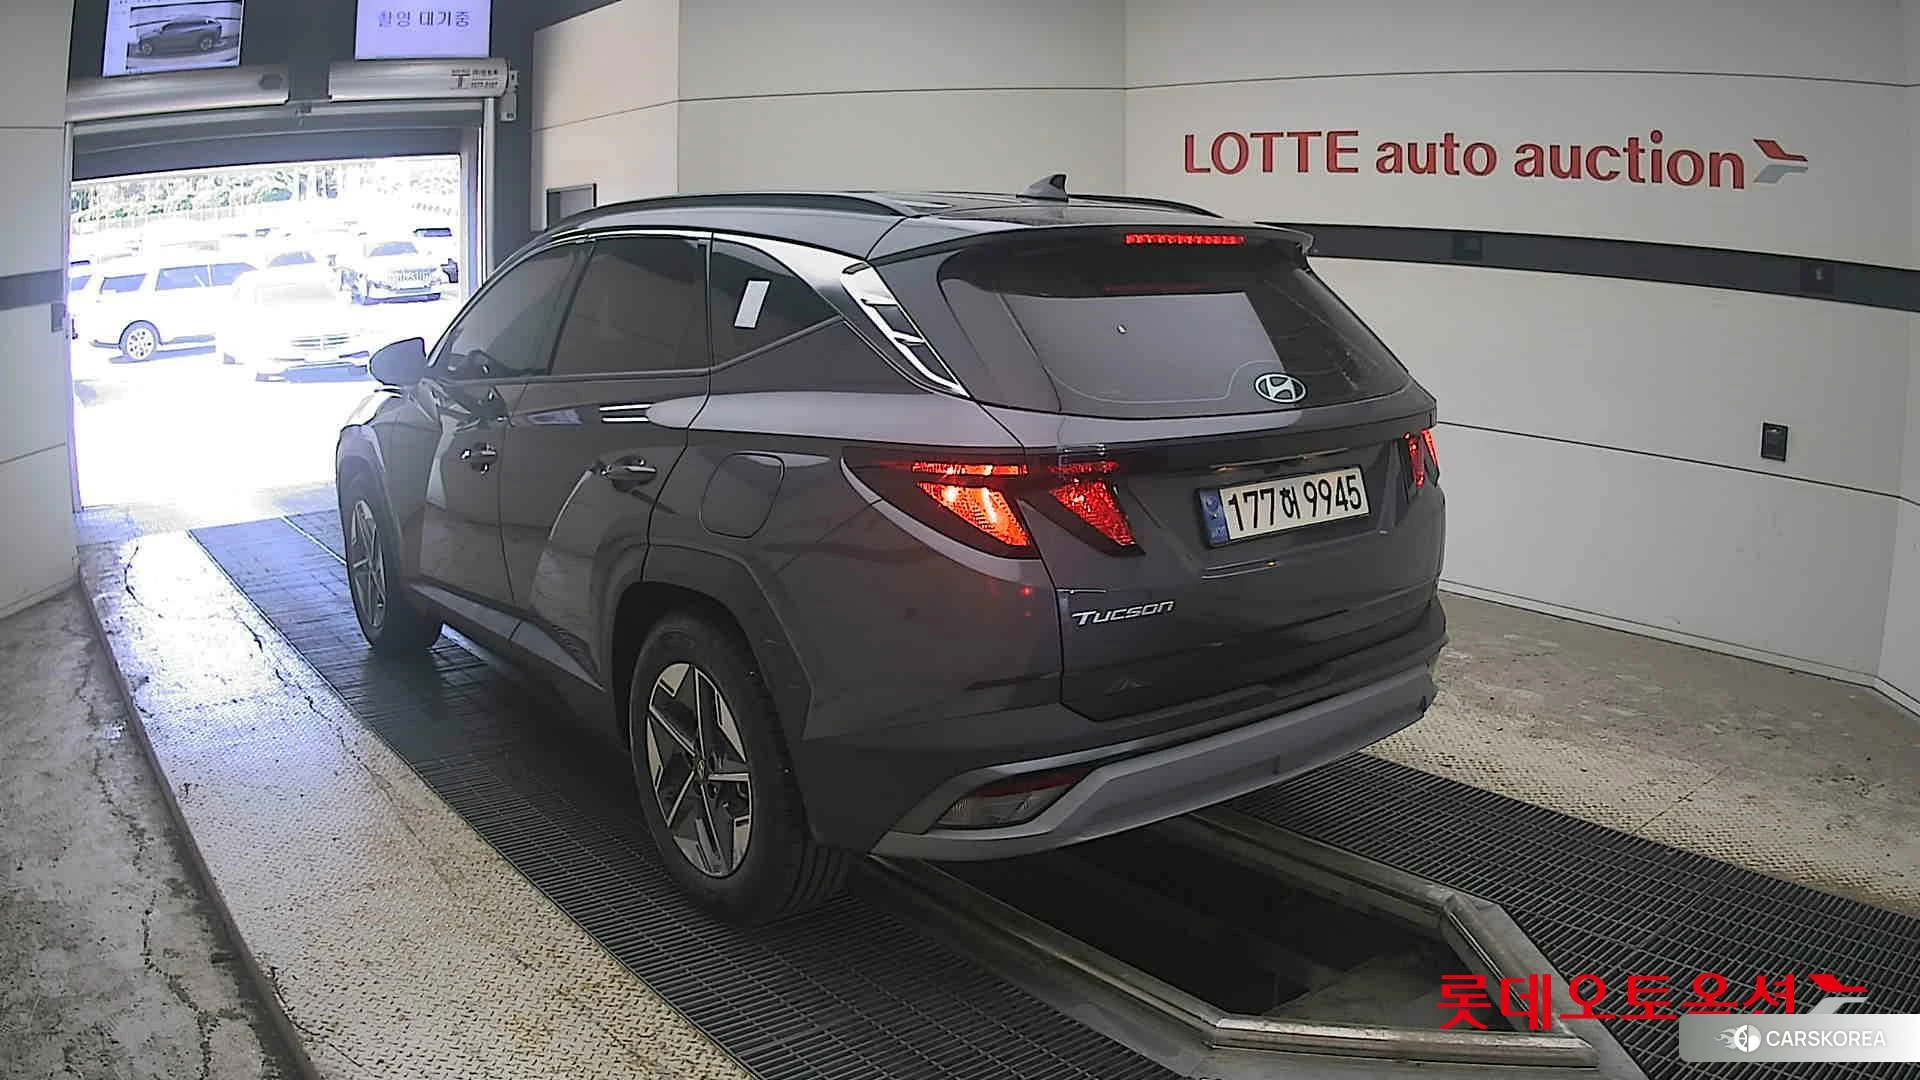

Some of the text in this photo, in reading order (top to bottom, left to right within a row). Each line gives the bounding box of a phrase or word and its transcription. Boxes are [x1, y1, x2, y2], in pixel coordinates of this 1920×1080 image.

[1184, 130, 1744, 189] LOTTE auto auction
